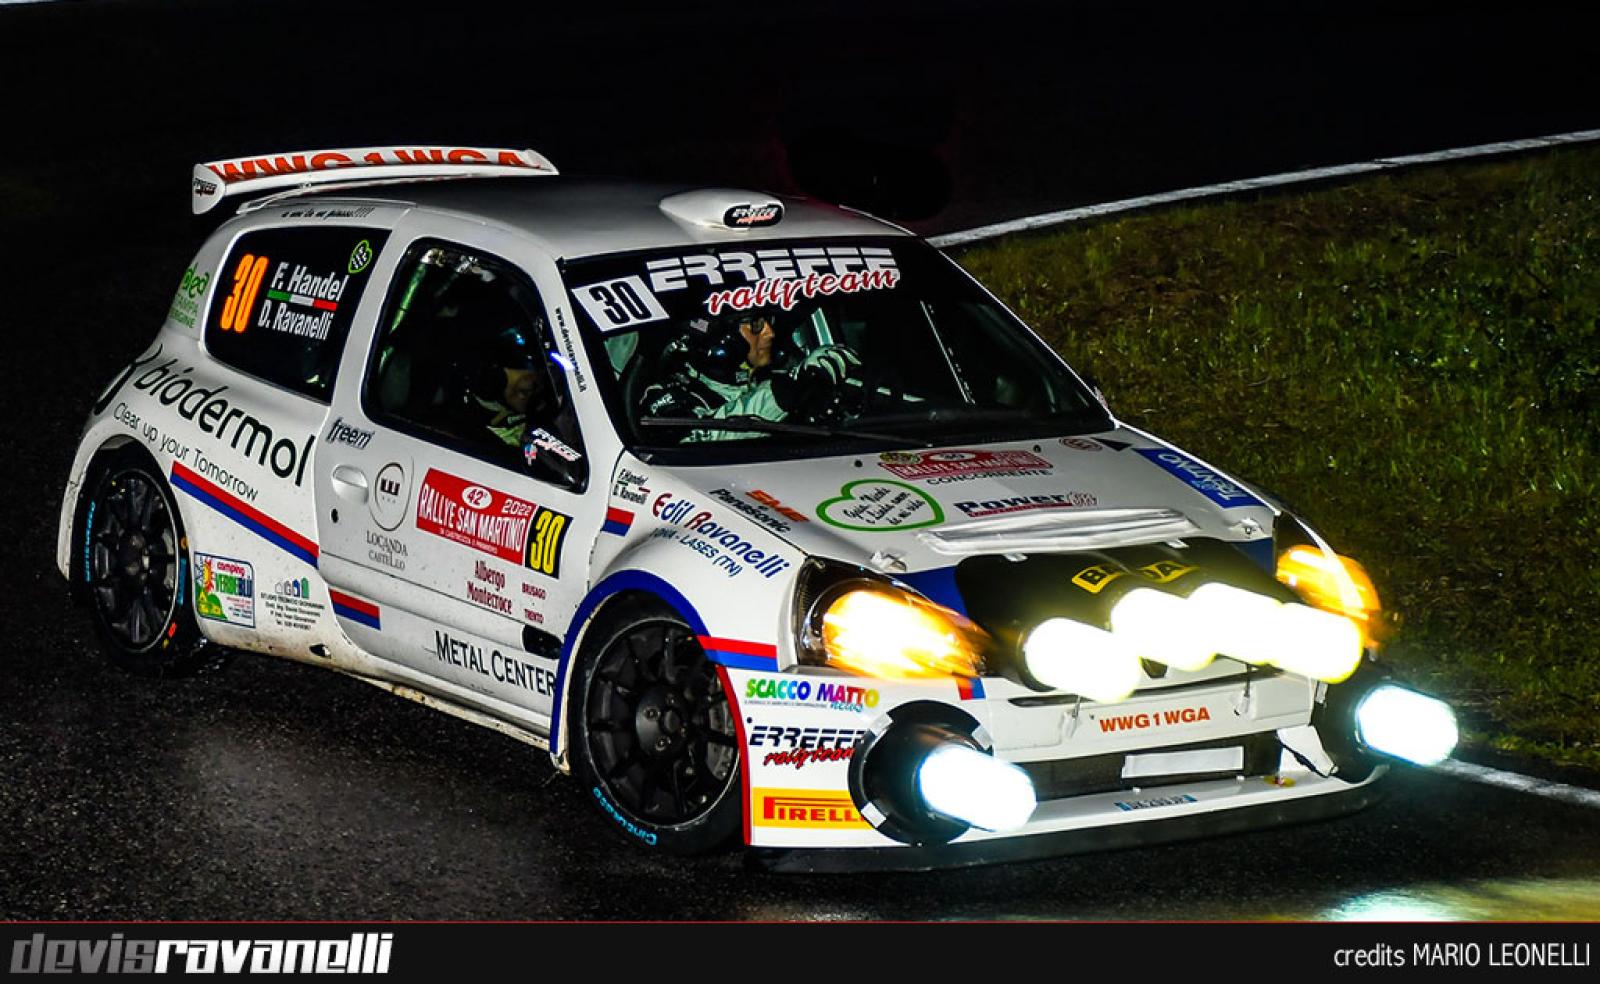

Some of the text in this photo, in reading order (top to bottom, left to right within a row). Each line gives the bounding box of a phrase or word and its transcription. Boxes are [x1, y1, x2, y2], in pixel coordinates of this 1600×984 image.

[271, 261, 350, 301] F. Handel
[647, 247, 896, 292] ERREFFE
[220, 254, 269, 333] 30
[588, 280, 652, 325] 30
[257, 299, 334, 341] D. Ravanelli
[133, 358, 317, 487] biodermol
[113, 402, 259, 502] Clear up your Tomorrow
[419, 483, 526, 553] RALLYE SAN MARTINO
[501, 499, 532, 516] 2022
[529, 510, 566, 575] 30
[652, 493, 791, 578] Edil Ravanelli
[680, 534, 720, 559] LASES
[475, 560, 506, 591] Albergo
[435, 630, 556, 696] METAL CENTER
[745, 678, 880, 708] SCACCO MATTO
